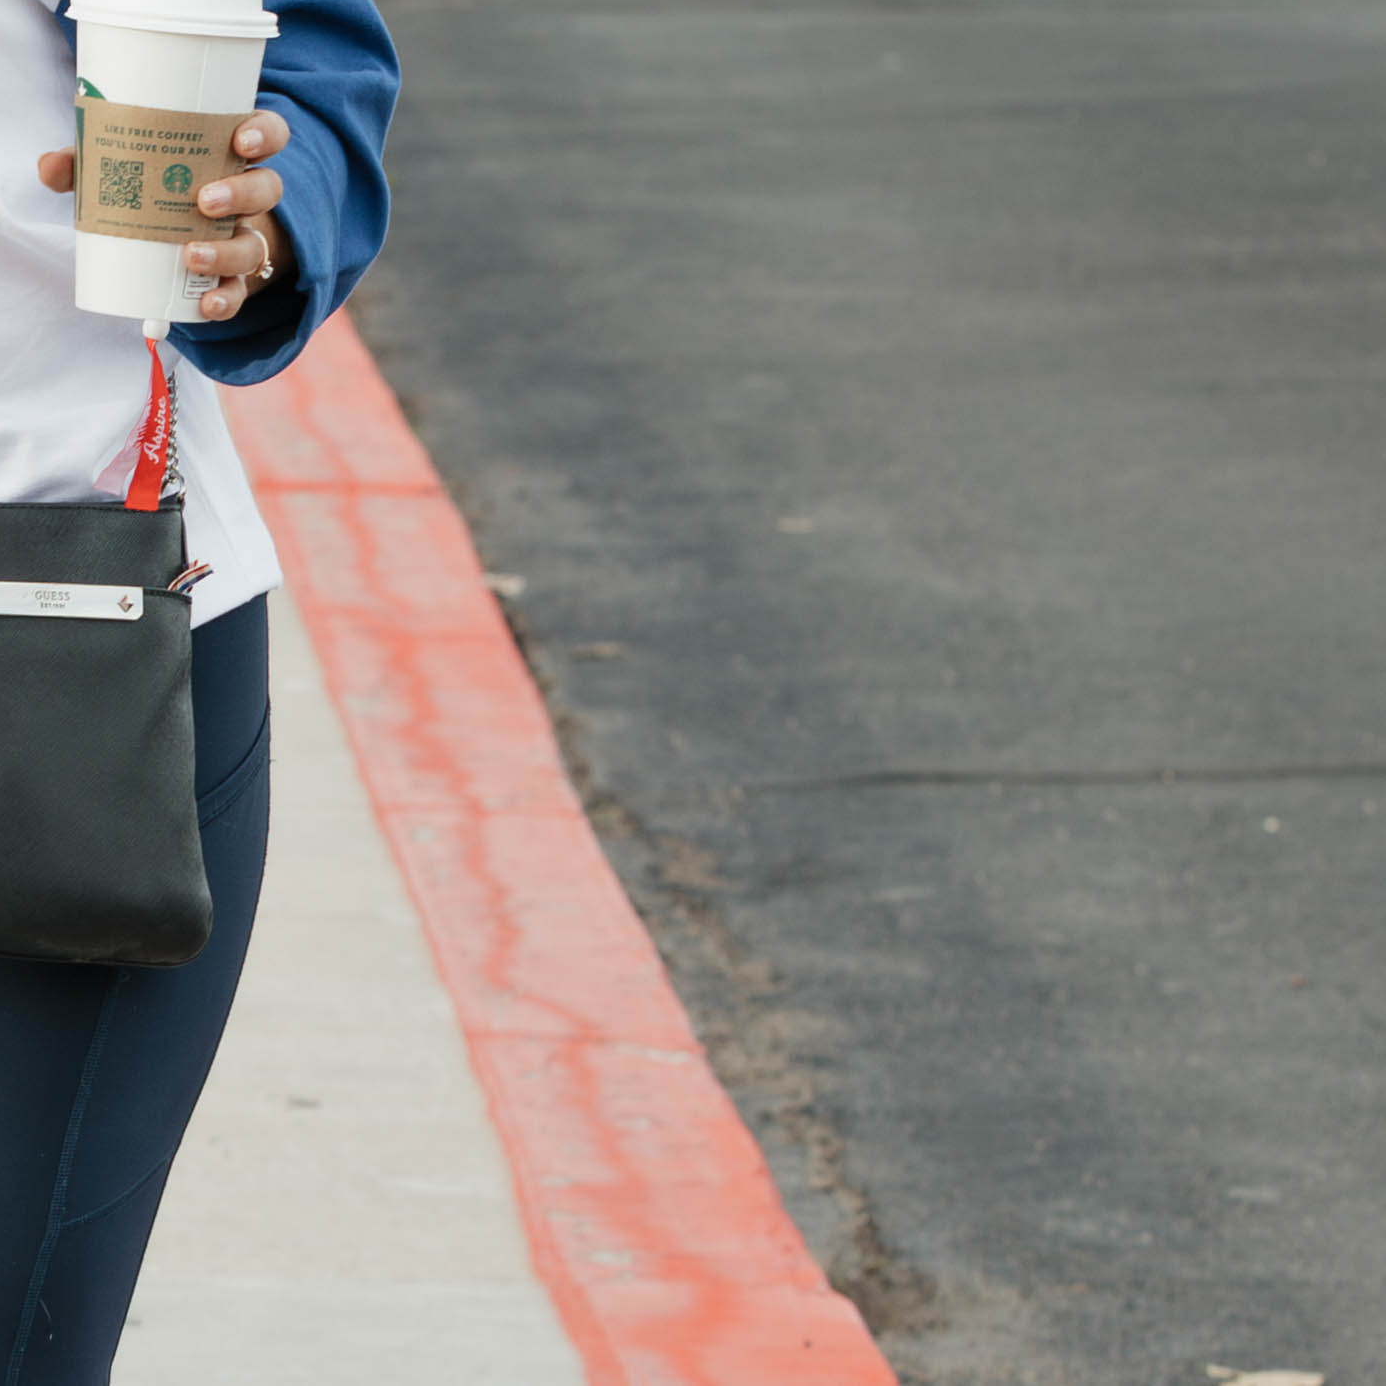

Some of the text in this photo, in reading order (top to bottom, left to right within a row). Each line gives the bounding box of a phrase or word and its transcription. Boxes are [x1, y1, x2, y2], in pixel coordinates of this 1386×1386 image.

[104, 125, 204, 142] LIKE FREE COFFEE?
[95, 137, 127, 150] YOU'LL
[130, 142, 157, 153] LOVE
[161, 146, 185, 155] OUR
[143, 396, 167, 464] Aspire
[34, 589, 71, 602] GUESS
